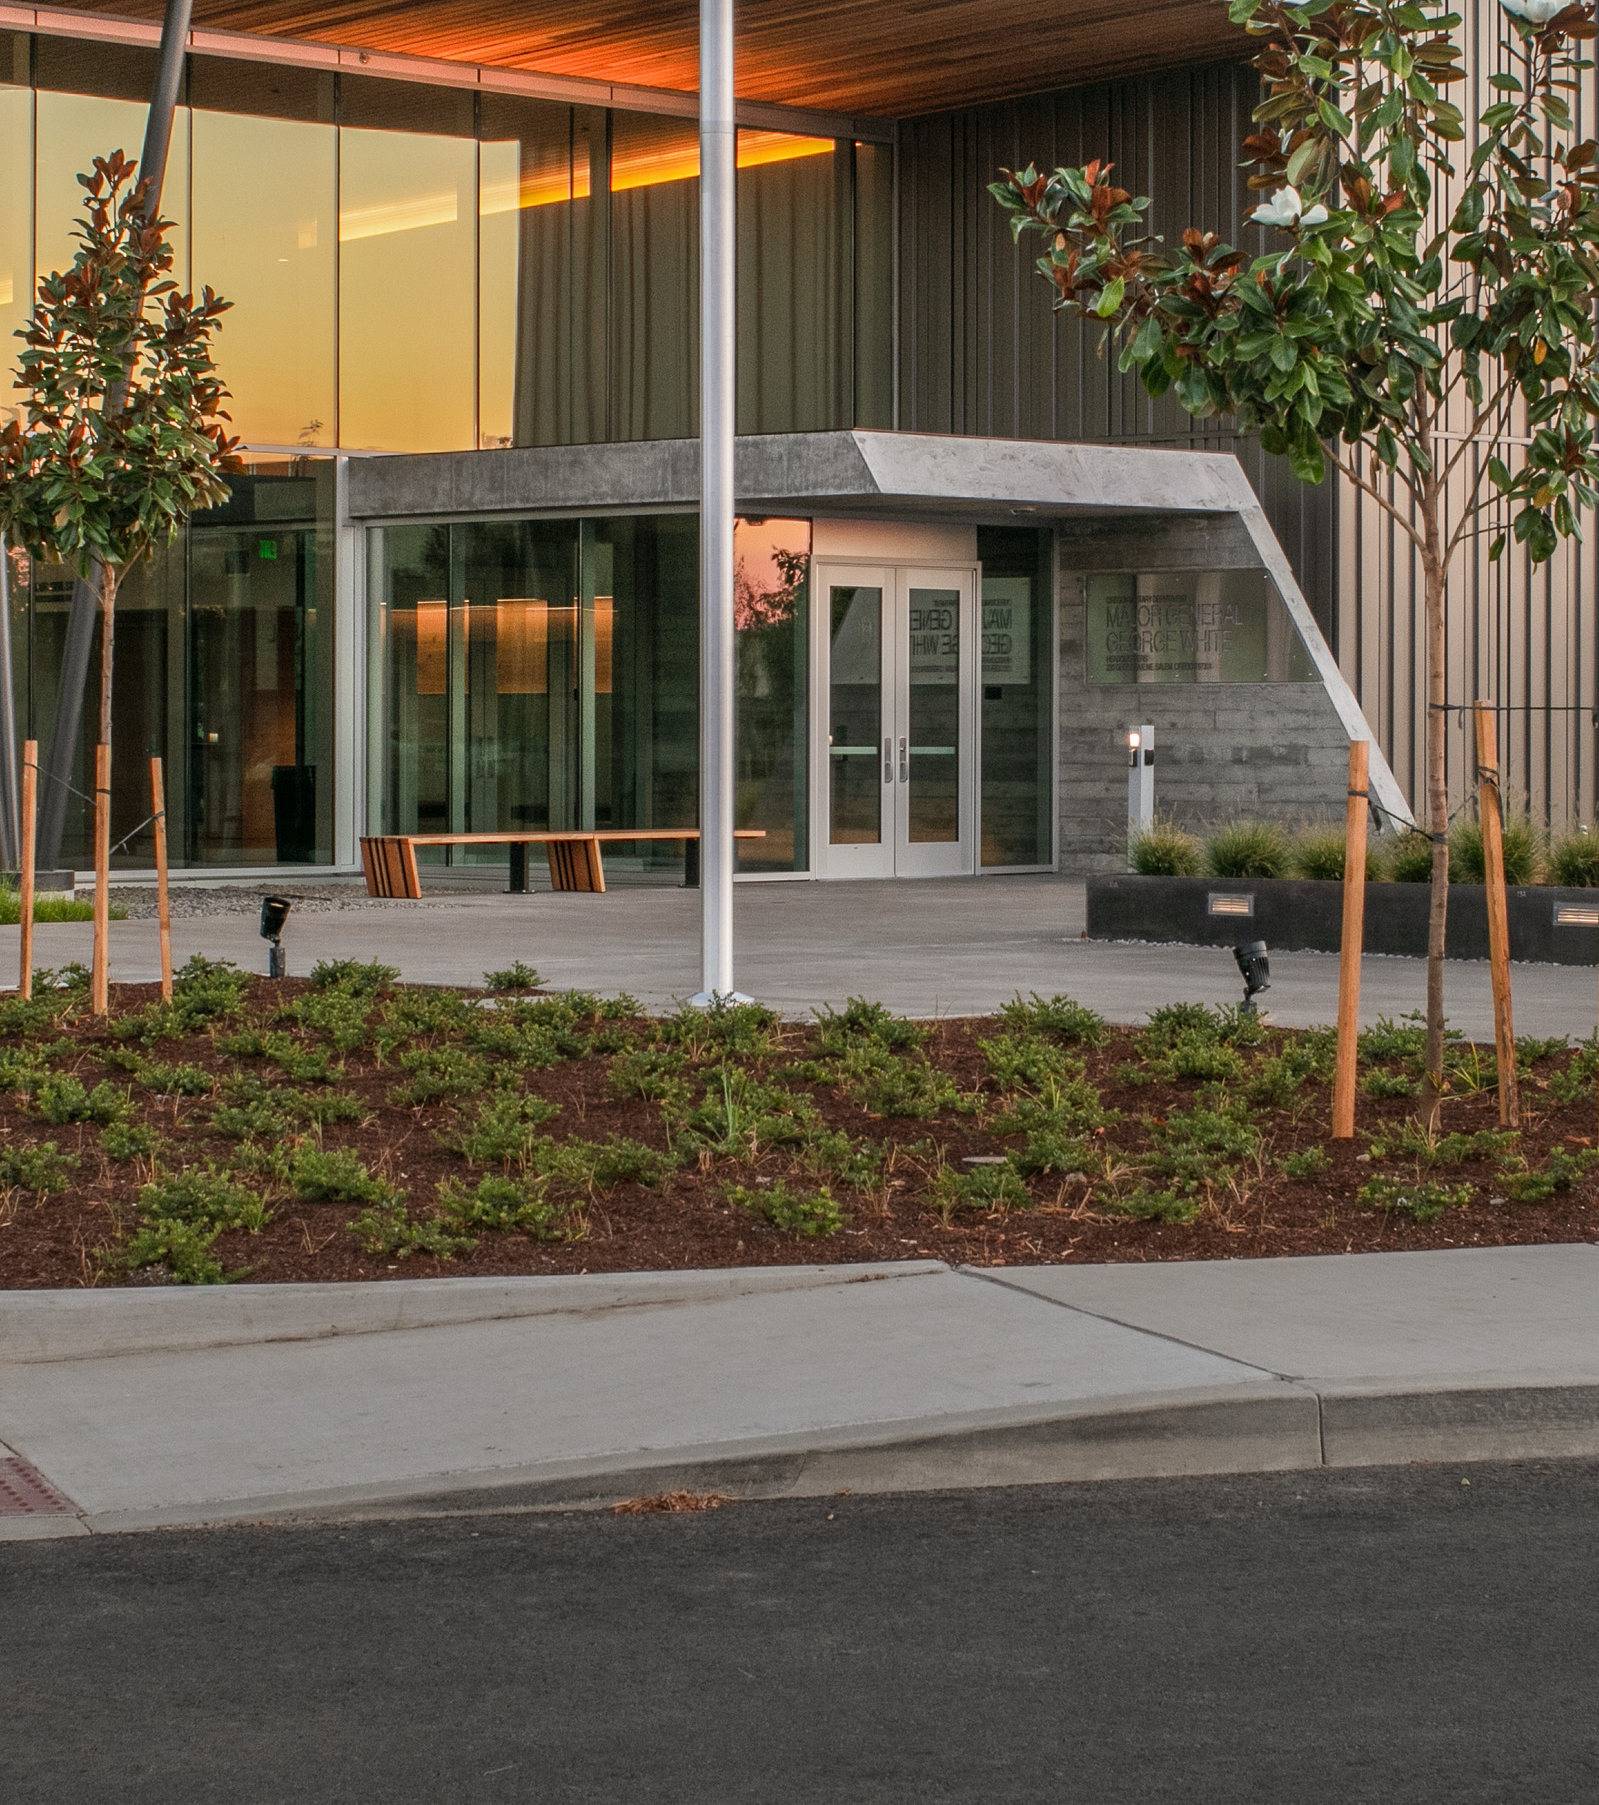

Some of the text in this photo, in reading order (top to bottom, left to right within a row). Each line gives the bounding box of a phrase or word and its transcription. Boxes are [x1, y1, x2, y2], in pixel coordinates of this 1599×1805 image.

[1166, 603, 1243, 626] GENERAL
[1106, 630, 1233, 653] GEORGE WHITE
